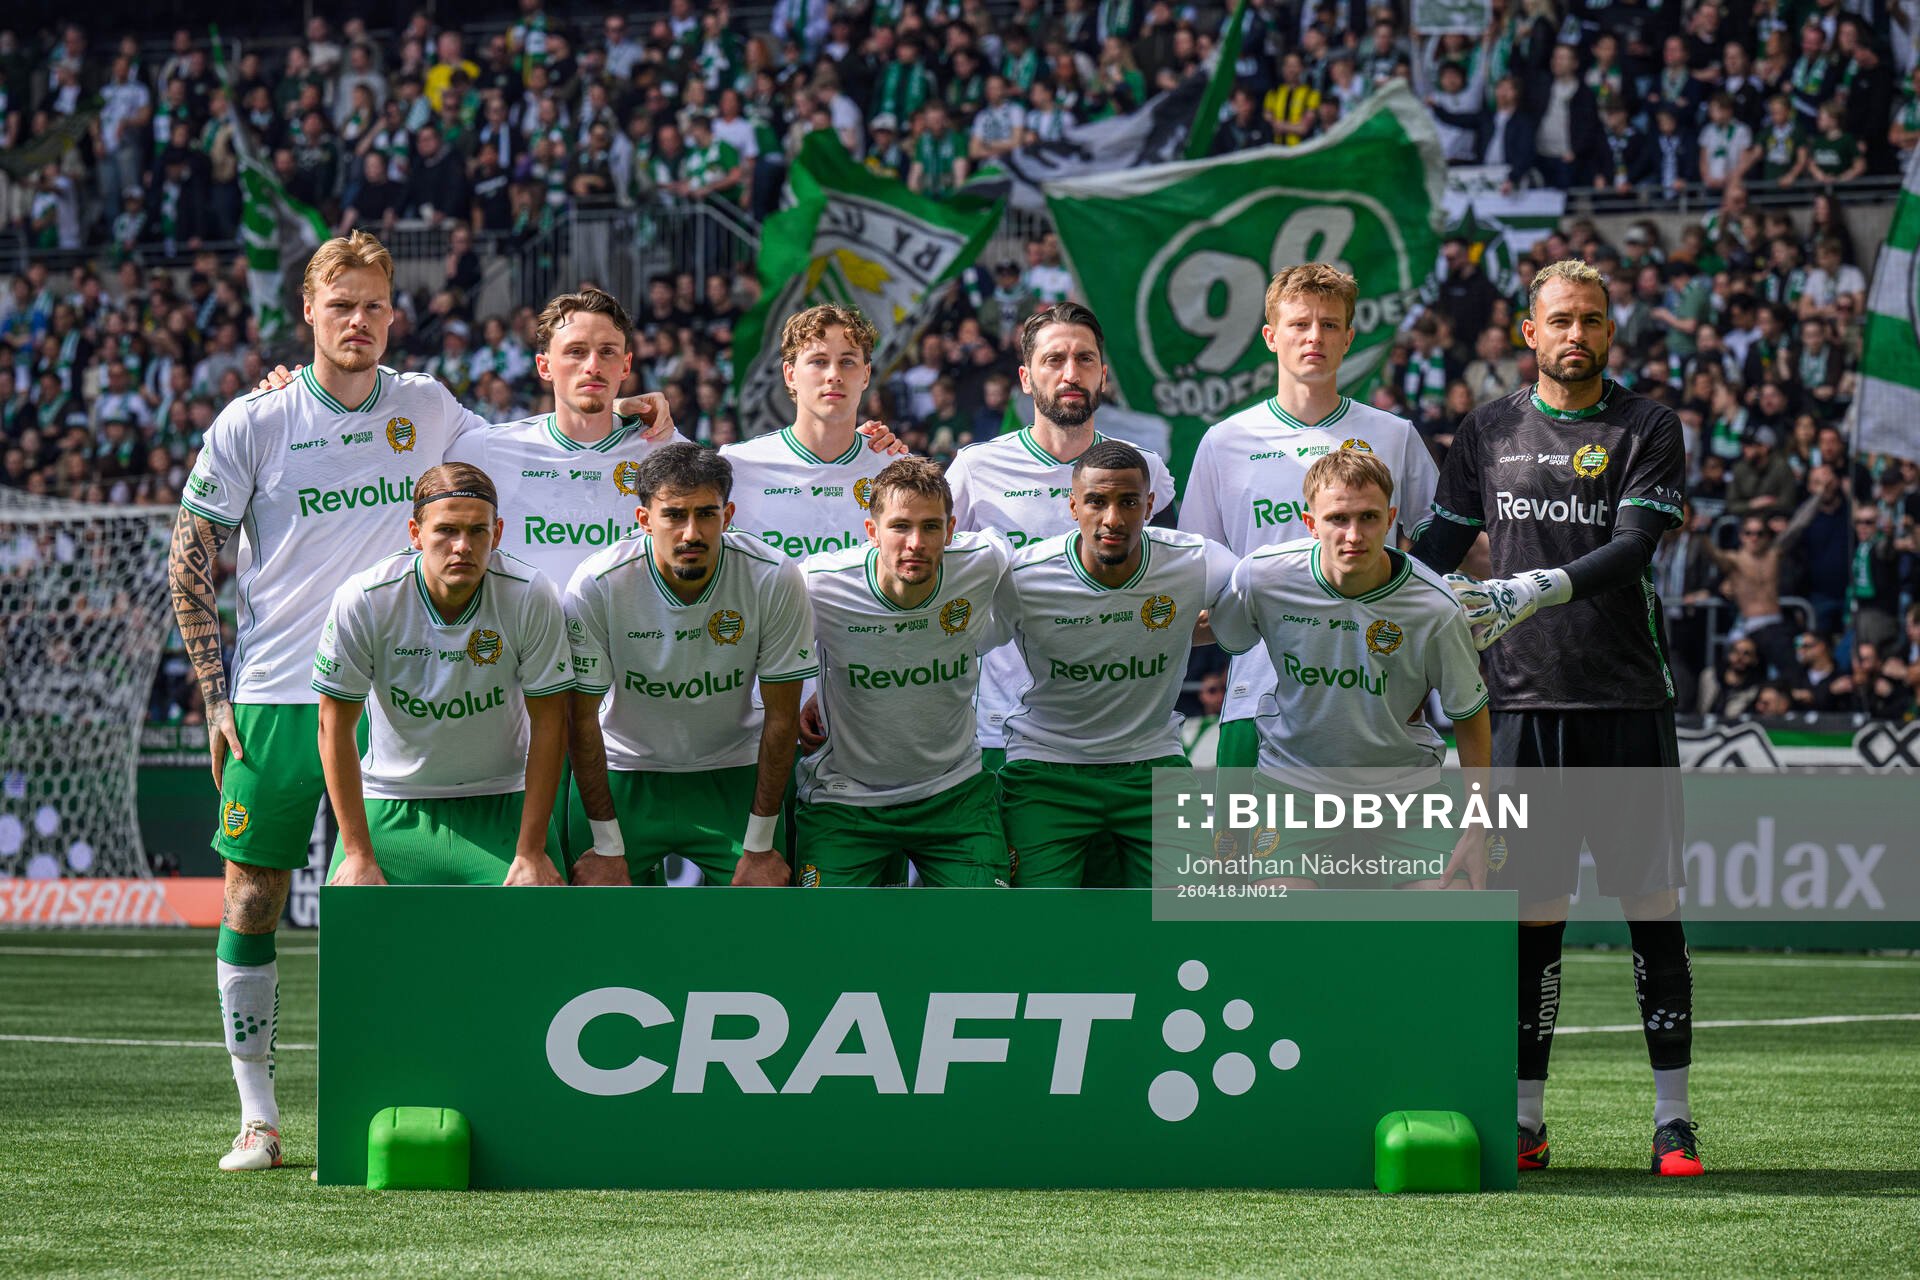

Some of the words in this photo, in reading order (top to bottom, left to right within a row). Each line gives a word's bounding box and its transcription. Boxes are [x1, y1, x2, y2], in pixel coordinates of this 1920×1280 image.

[353, 431, 373, 439] INTER
[290, 440, 319, 451] CRAFT
[354, 437, 374, 445] SPORT
[1249, 452, 1278, 461] CRAFT
[1499, 455, 1526, 464] CRAFT
[521, 470, 551, 478] CRAFT
[764, 486, 794, 495] CRAFT
[1004, 490, 1033, 498] CRAFT
[298, 476, 414, 517] Revolut
[1496, 491, 1608, 527] Revolut
[1112, 610, 1134, 618] INTER
[908, 618, 929, 627] INTER
[1055, 617, 1084, 625] CRAFT
[1113, 616, 1133, 624] SPORT
[1282, 614, 1313, 626] CRAFT
[1340, 618, 1360, 627] INTER
[848, 625, 877, 633] CRAFT
[908, 624, 929, 632] SPORT
[1340, 625, 1360, 633] SPORT
[628, 631, 657, 640] CRAFT
[394, 647, 424, 657] CRAFT
[848, 653, 969, 690] Revolut
[1048, 653, 1168, 682] Revolut
[1283, 652, 1388, 696] Revolut
[624, 668, 745, 699] Revolut
[390, 685, 505, 721] Revolut
[546, 986, 1136, 1096] CRAFT
